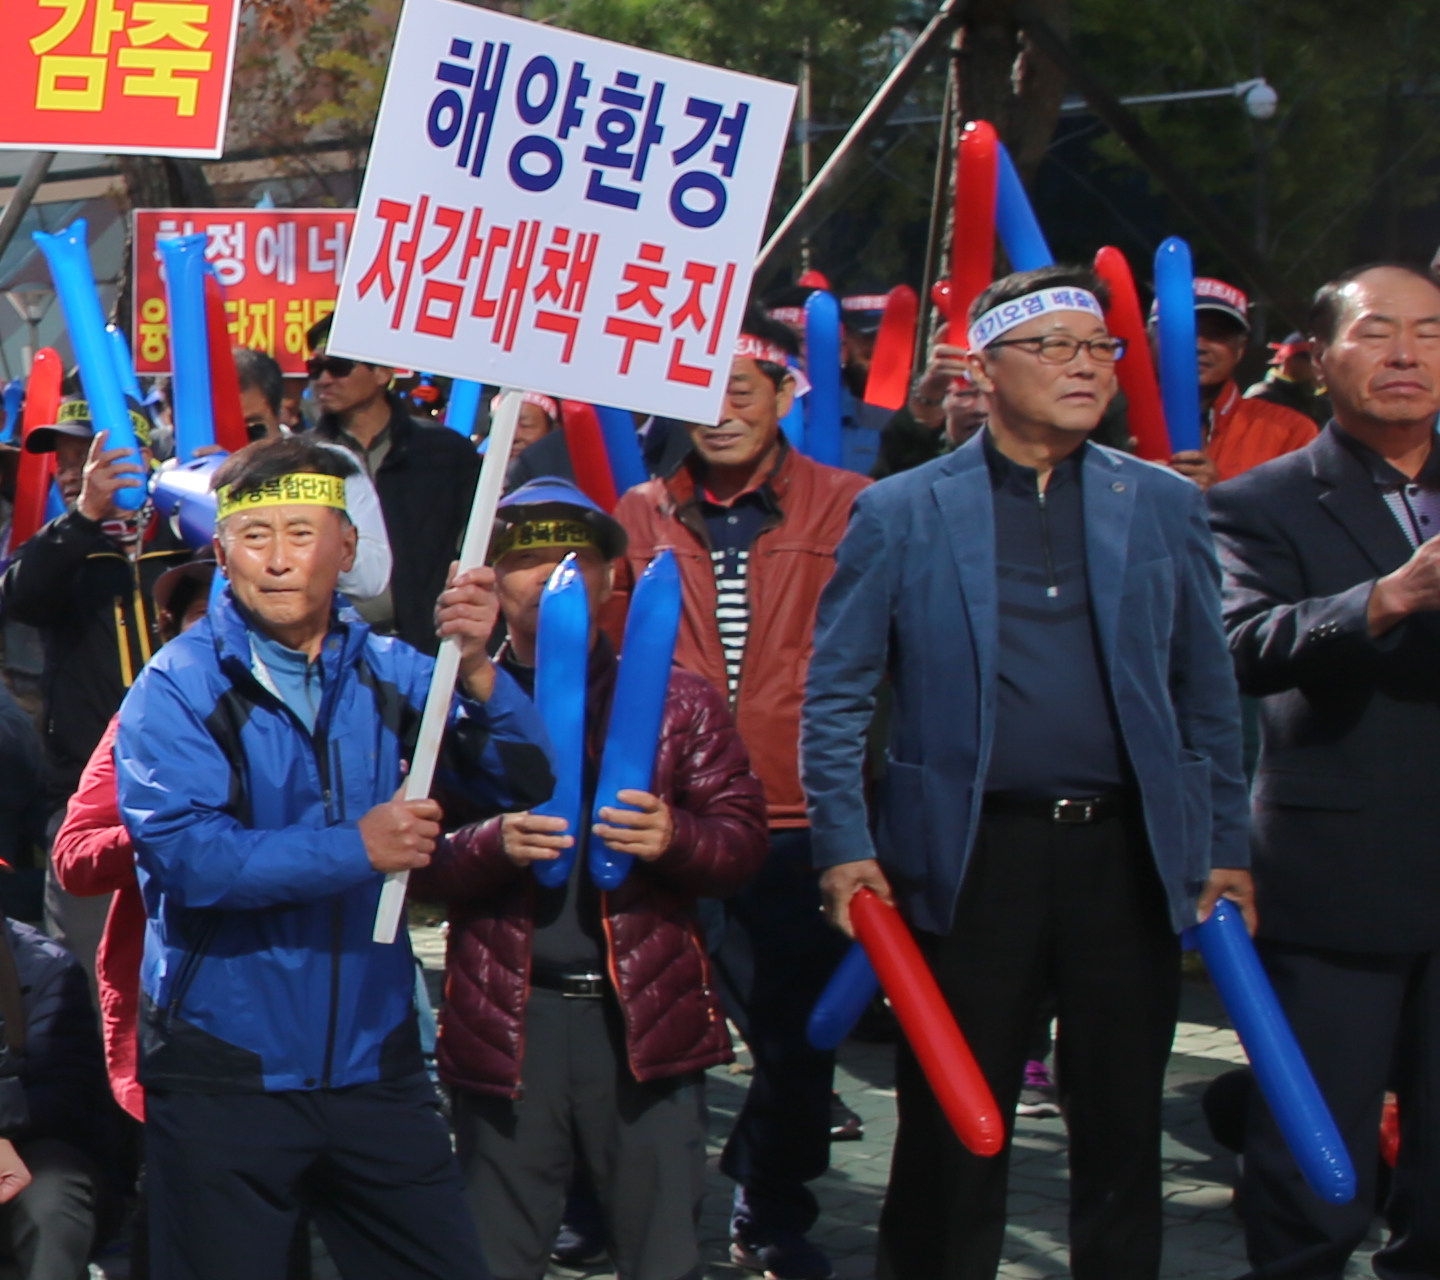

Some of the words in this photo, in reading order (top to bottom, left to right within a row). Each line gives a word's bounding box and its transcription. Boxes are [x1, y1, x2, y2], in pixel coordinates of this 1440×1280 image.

[426, 36, 752, 231] 해양환경
[356, 193, 600, 364] 저감대책
[603, 241, 737, 391] 추진
